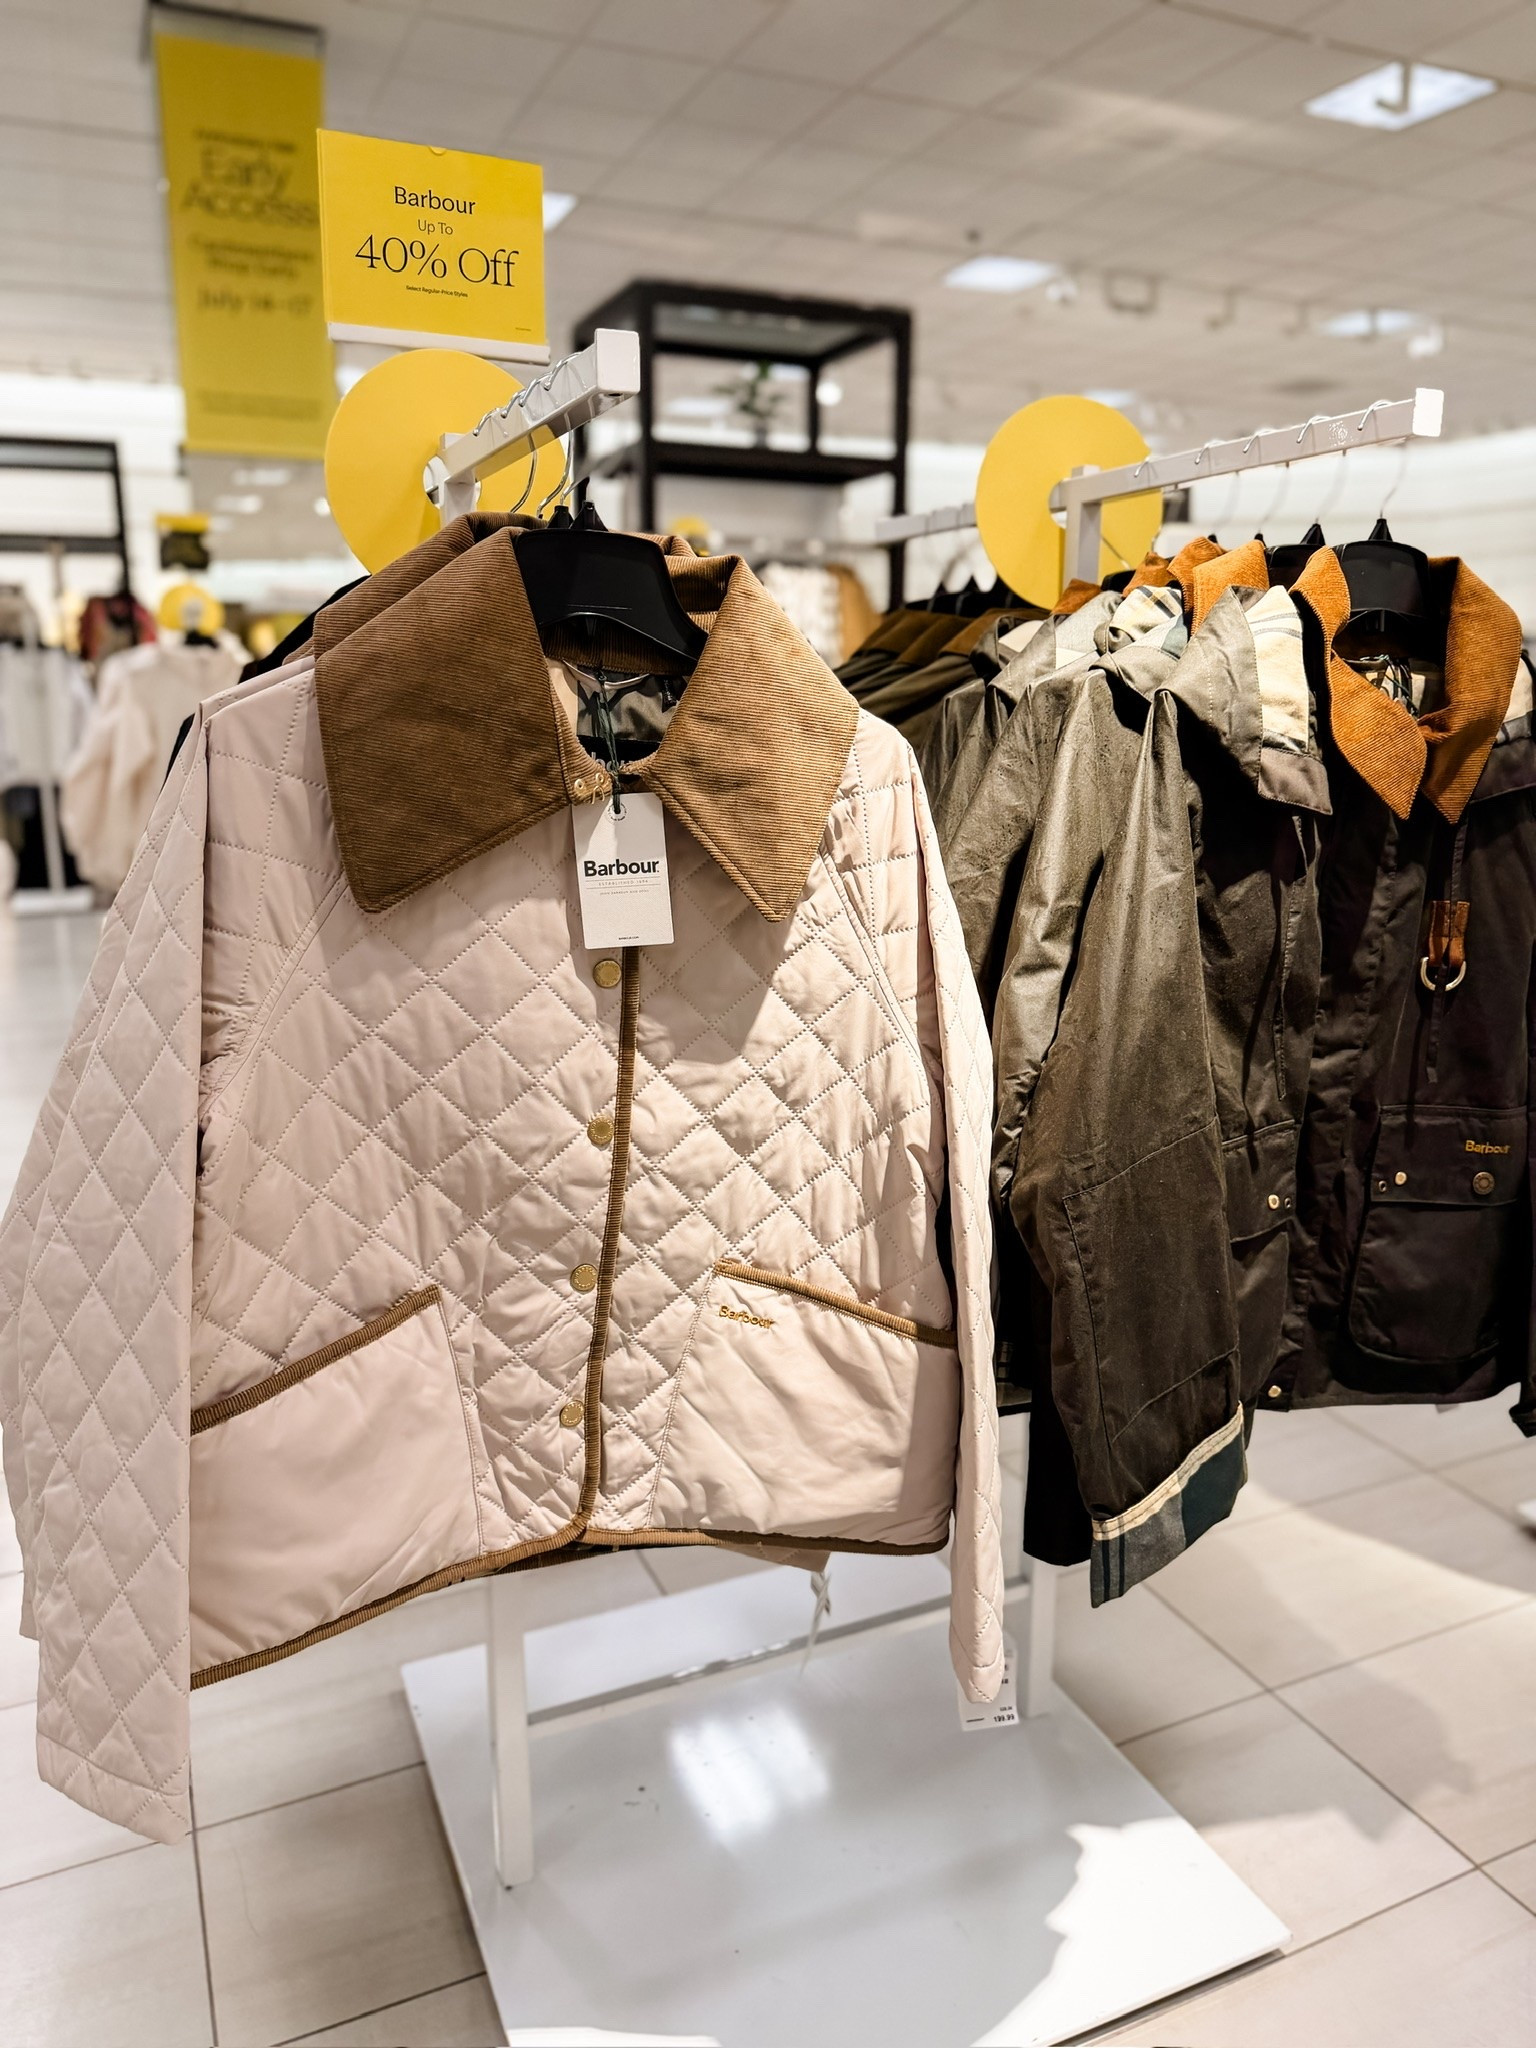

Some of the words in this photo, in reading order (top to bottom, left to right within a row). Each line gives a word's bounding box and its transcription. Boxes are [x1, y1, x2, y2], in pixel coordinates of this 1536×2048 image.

[394, 186, 476, 215] Barbour
[418, 219, 435, 235] Up
[437, 222, 453, 235] To
[355, 234, 447, 279] 40%
[458, 248, 519, 287] Off
[1465, 1140, 1511, 1154] Barbour
